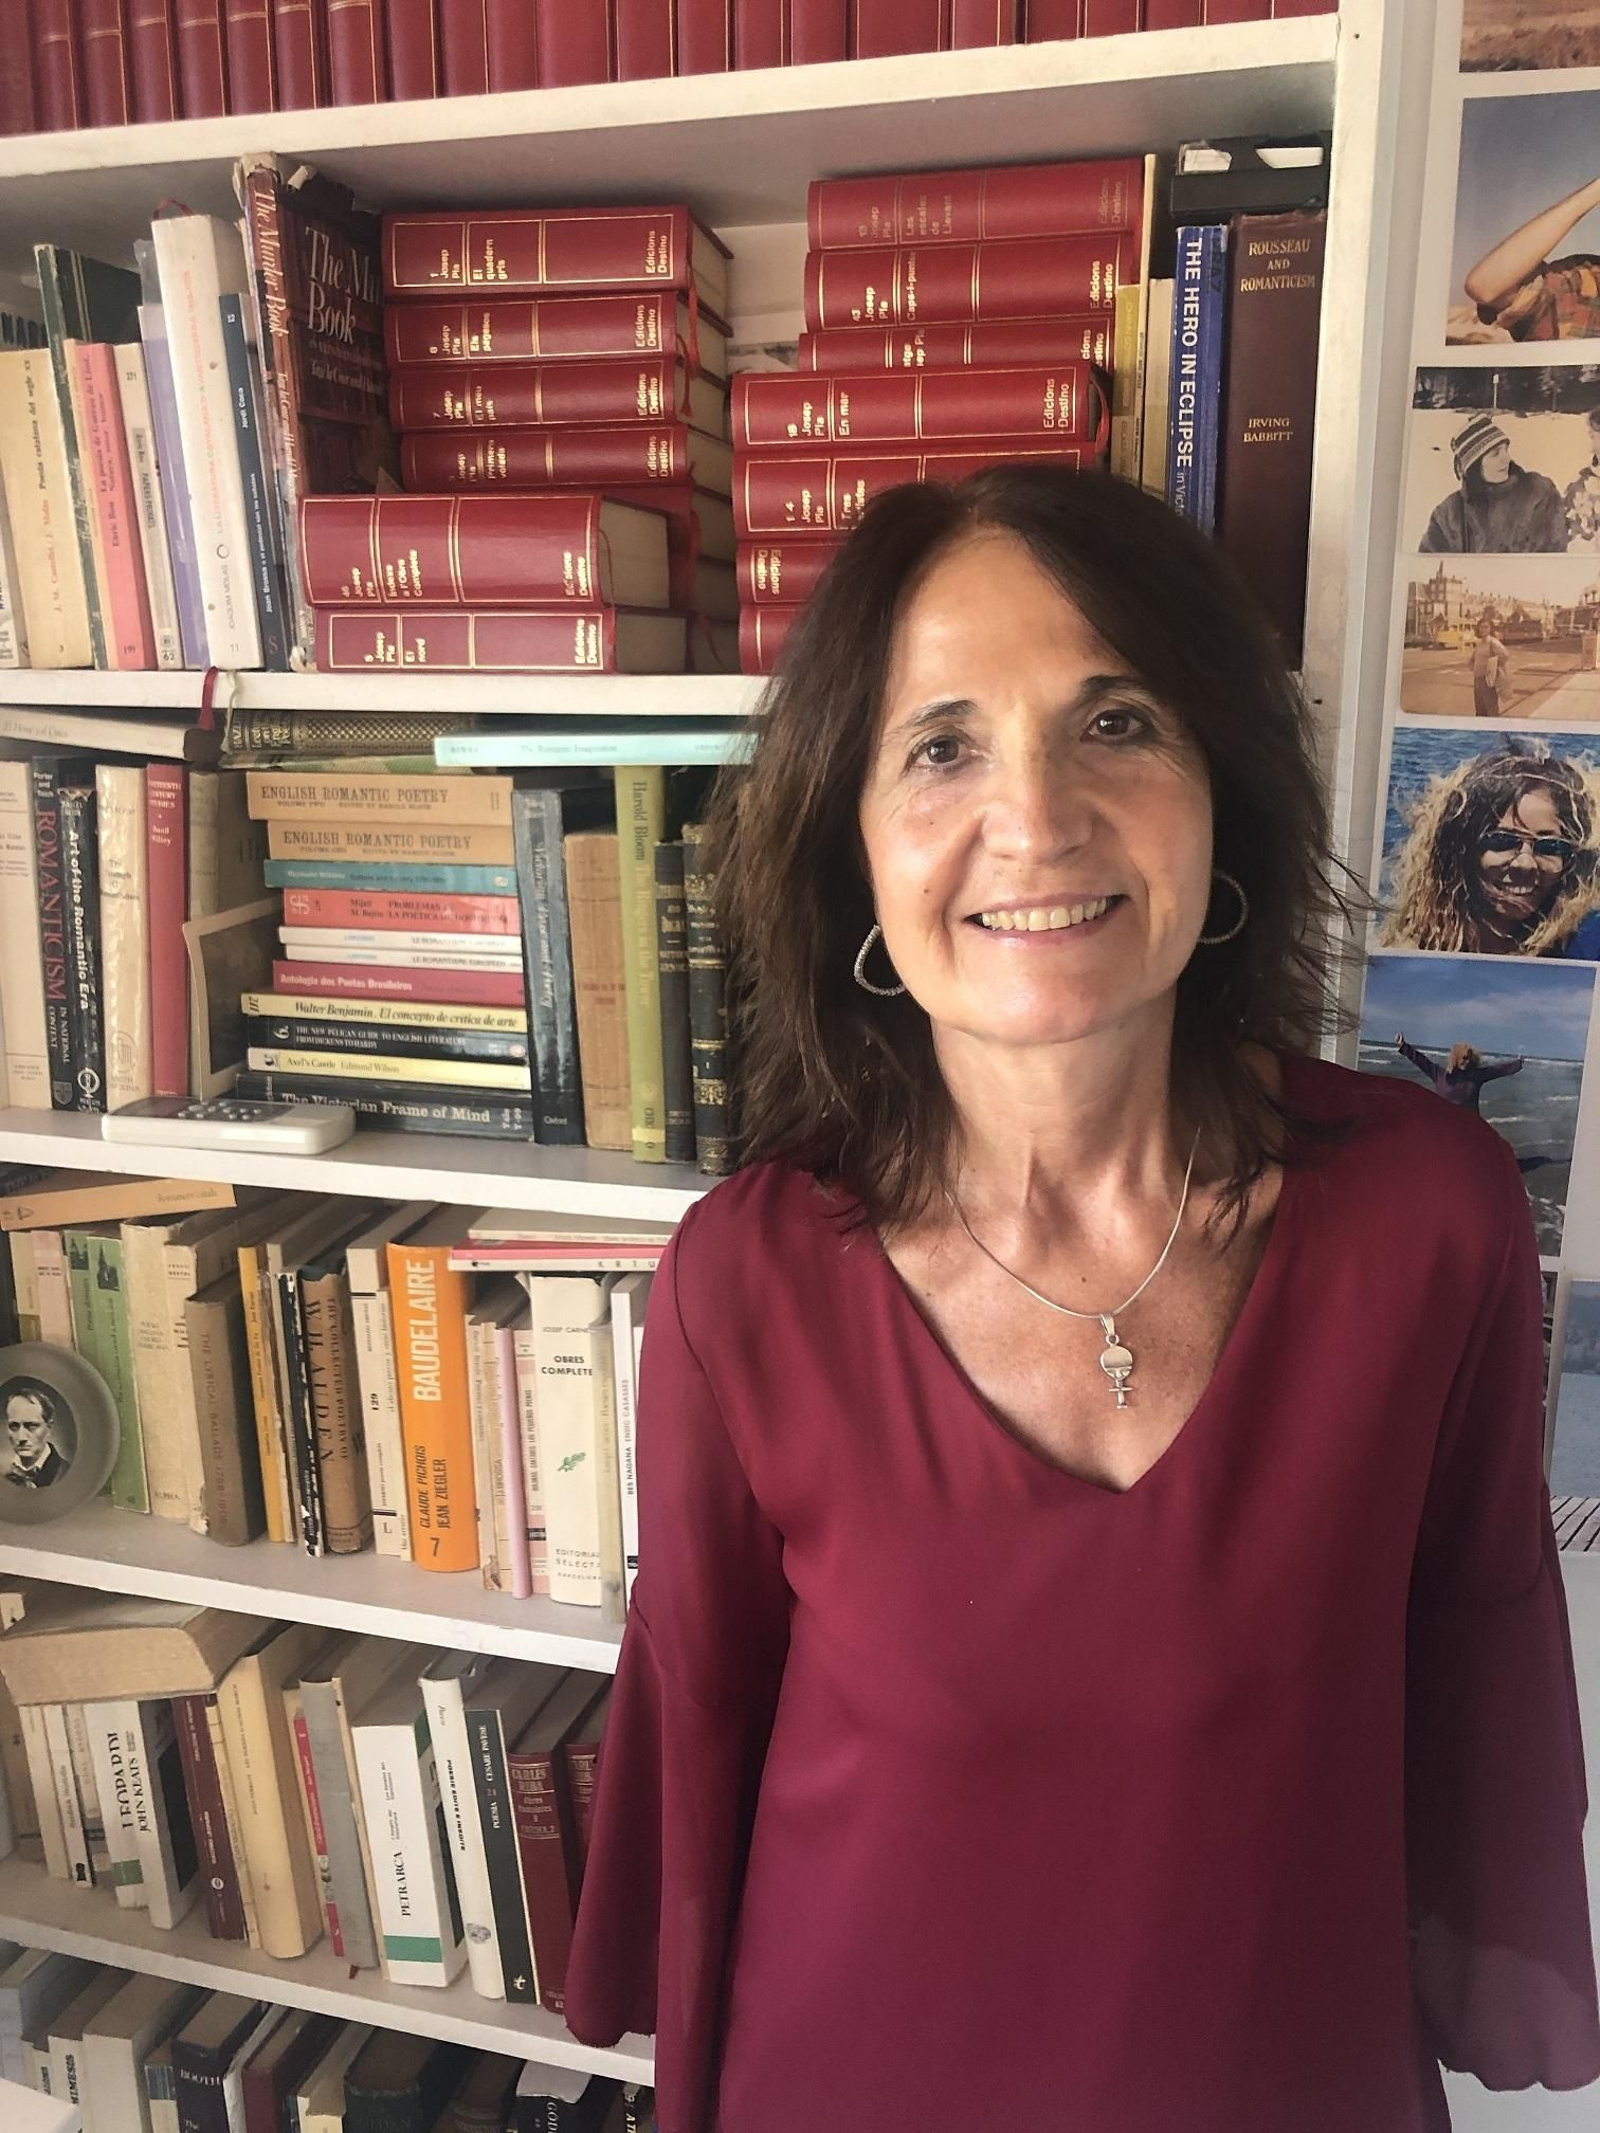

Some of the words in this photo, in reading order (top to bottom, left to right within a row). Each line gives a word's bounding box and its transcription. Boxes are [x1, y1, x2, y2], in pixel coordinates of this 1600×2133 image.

[253, 188, 277, 224] The
[257, 223, 284, 291] Murder
[440, 249, 449, 279] Josep
[484, 239, 496, 280] quadern
[645, 230, 656, 274] Edicions
[657, 235, 667, 274] Destino
[1184, 237, 1203, 281] THE
[1249, 239, 1311, 257] ROUSSEAU
[452, 263, 460, 279] Pla
[473, 269, 483, 280] El
[496, 259, 508, 280] gris
[1267, 259, 1290, 272] AND
[1090, 260, 1101, 309] Edicions
[1103, 263, 1114, 309] Destino
[1240, 274, 1316, 293] ROMANTICISM
[865, 286, 876, 322] Josep
[878, 300, 889, 320] Pla
[1181, 287, 1200, 348] HERO
[442, 325, 451, 355] Josep
[635, 304, 645, 348] Edicions
[647, 308, 657, 348] Destino
[452, 338, 461, 355] Pla
[1180, 354, 1197, 376] IN
[238, 387, 247, 408] Coca
[444, 390, 454, 420] Josep
[454, 402, 464, 419] Pla
[637, 373, 648, 416] Edicions
[649, 377, 659, 415] Destino
[1043, 378, 1055, 429] Edicions
[1058, 383, 1070, 428] Destino
[801, 402, 813, 437] Josep
[815, 415, 826, 437] Pla
[839, 419, 850, 437] En
[1176, 380, 1196, 469] ECLIPSE
[1248, 417, 1291, 429] IRVING
[1243, 431, 1294, 443] BABBITT
[647, 436, 658, 477] Edicions
[658, 440, 668, 478] Destino
[801, 490, 812, 523] Josep
[815, 506, 824, 524] Pla
[352, 567, 364, 598] Josep
[366, 581, 376, 598] Pla
[577, 556, 588, 597] Destino
[375, 631, 386, 663] Josep
[386, 644, 396, 663] Pla
[574, 618, 586, 664] Edicions
[587, 623, 598, 664] Destino
[262, 786, 317, 800] ENGLISH
[323, 787, 390, 802] ROMANTIC
[397, 788, 448, 804] POETRY
[633, 781, 648, 822] Harold
[69, 830, 79, 856] Art
[283, 831, 340, 845] ENGLISH
[346, 832, 414, 848] ROMANTIC
[420, 834, 472, 850] POETRY
[635, 825, 649, 862] Bloom
[71, 857, 82, 876] of
[36, 810, 68, 1000] ROMANTICISM
[72, 876, 83, 904] the
[74, 907, 88, 980] Romantic
[79, 982, 90, 1010] Era
[280, 973, 318, 987] Antologia
[320, 976, 336, 987] dos
[337, 977, 366, 988] Poetas
[294, 1002, 325, 1013] Walter
[379, 1008, 391, 1018] El
[392, 1008, 436, 1023] concepto
[437, 1012, 448, 1021] de
[483, 1015, 495, 1025] de
[497, 1016, 518, 1027] arte
[296, 1026, 309, 1035] THE
[311, 1058, 336, 1069] Castle
[381, 1101, 429, 1118] Frame
[432, 1106, 447, 1118] of
[451, 1106, 491, 1123] Mind
[405, 1259, 442, 1402] BAUDELAIRE
[553, 1354, 585, 1364] OBRES
[311, 1364, 334, 1462] AUDEN
[415, 1444, 427, 1487] PICHOIS
[625, 1445, 634, 1480] NAGANA
[434, 1458, 449, 1501] ZIEGLER
[418, 1491, 430, 1530] CLAUDE
[436, 1504, 450, 1530] JEAN
[430, 1536, 441, 1557] 7
[129, 1756, 145, 1796] KEATS
[482, 1755, 494, 1783] CESARE
[511, 1768, 547, 1781] CARLES
[134, 1800, 152, 1833] JOHN
[447, 1758, 457, 1788] POESIE
[457, 1820, 466, 1851] INEDITE
[393, 1850, 412, 1917] PETRARCA
